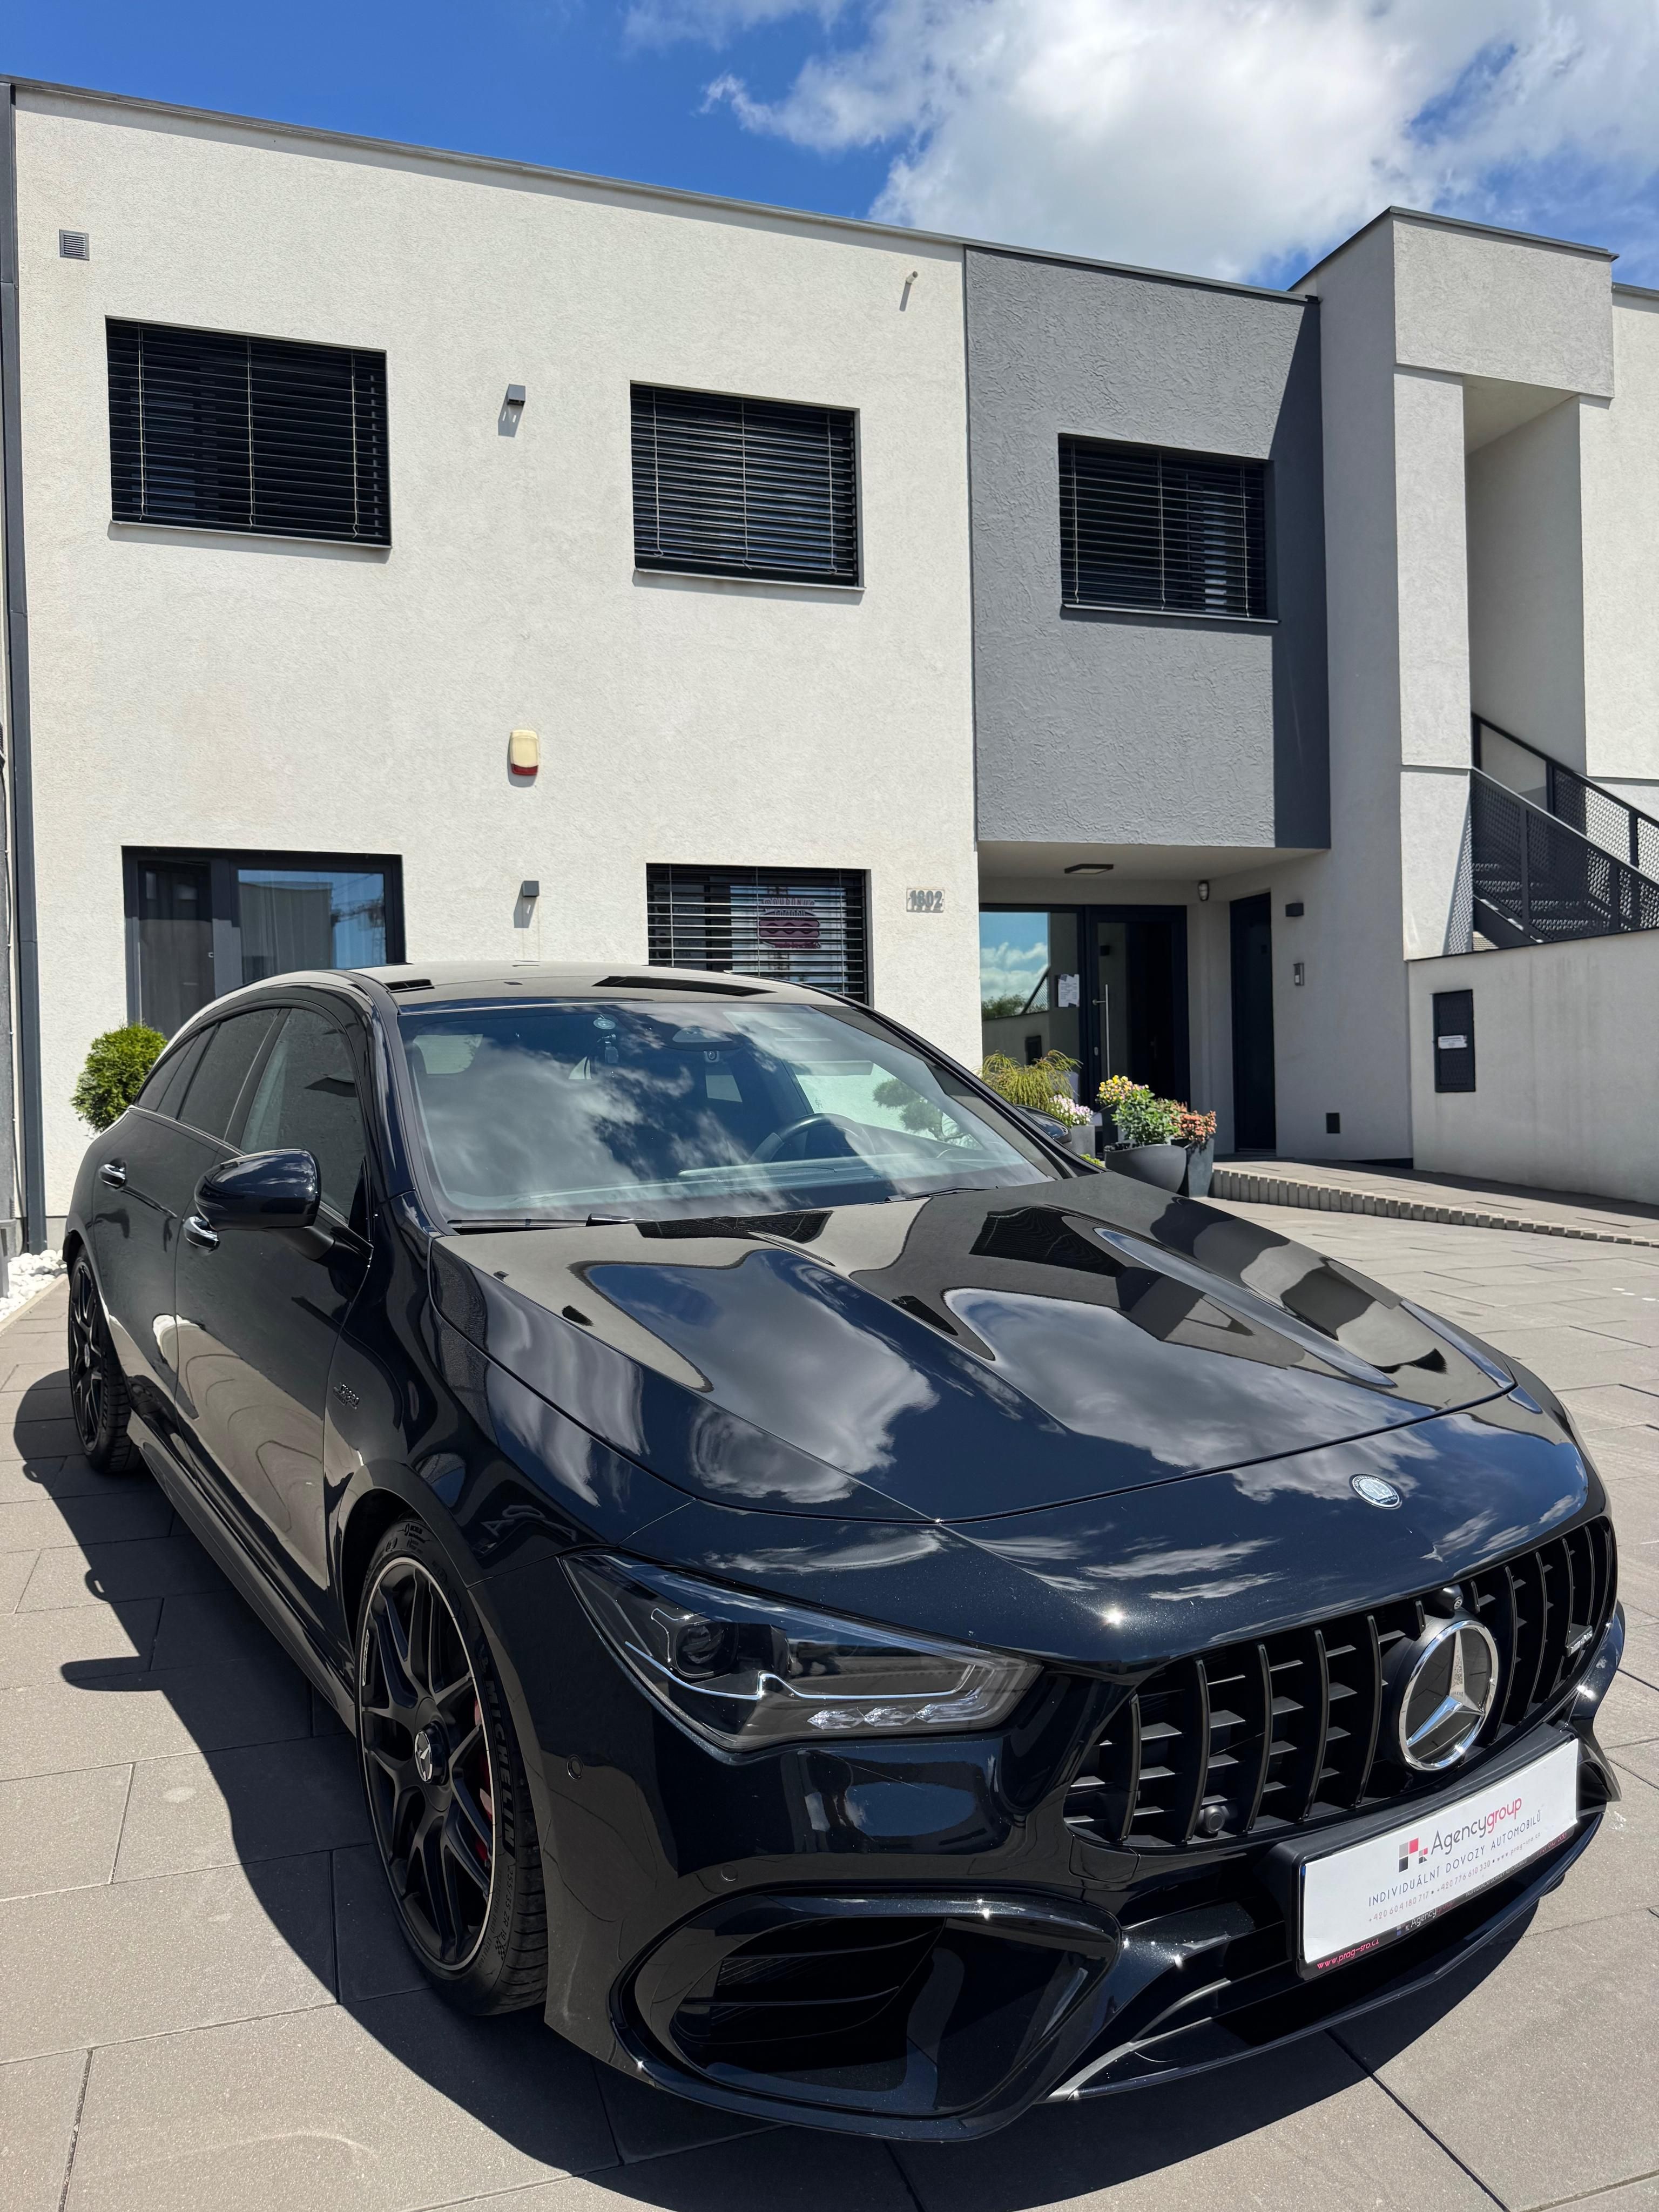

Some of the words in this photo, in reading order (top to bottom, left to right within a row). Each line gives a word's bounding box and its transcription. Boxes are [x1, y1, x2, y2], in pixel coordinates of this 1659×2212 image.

[910, 890, 942, 907] 1802
[484, 1680, 515, 1848] MICHELIN
[1431, 1797, 1522, 1855] Agencygroup
[1369, 1866, 1440, 1907] INDIVIDUÁLNÍ
[1446, 1845, 1485, 1873] DOVOZY
[1491, 1810, 1541, 1850] AUTOMOBILŮ
[505, 1869, 514, 1911] 255/35
[1369, 1910, 1387, 1921] +420
[1390, 1903, 1404, 1915] 604
[1405, 1897, 1417, 1908] 180
[1418, 1891, 1429, 1903] 717
[1437, 1879, 1453, 1892] +420
[1454, 1873, 1466, 1885] 776
[1468, 1867, 1478, 1877] 610
[1480, 1860, 1491, 1872] 330
[1317, 1938, 1379, 1970] www.prag-sro.cz
